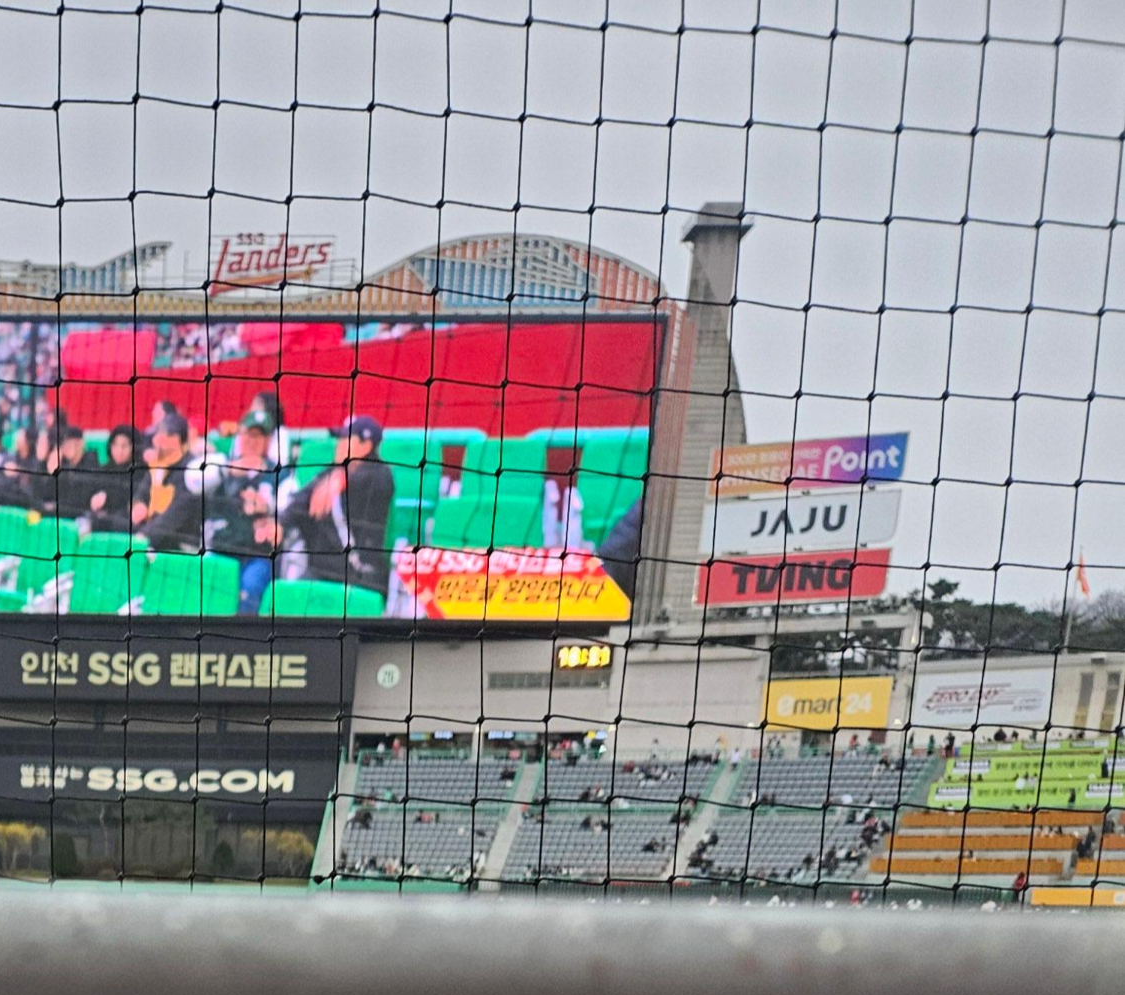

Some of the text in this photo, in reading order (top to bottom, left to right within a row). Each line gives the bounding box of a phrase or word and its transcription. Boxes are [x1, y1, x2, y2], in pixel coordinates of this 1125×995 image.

[824, 445, 900, 479] Point
[750, 504, 848, 538] JAJU
[732, 558, 852, 594] TVING
[20, 652, 308, 687] 인천 SSG 랜더스필드
[845, 692, 873, 714] 24
[87, 767, 295, 793] SSG.COM
